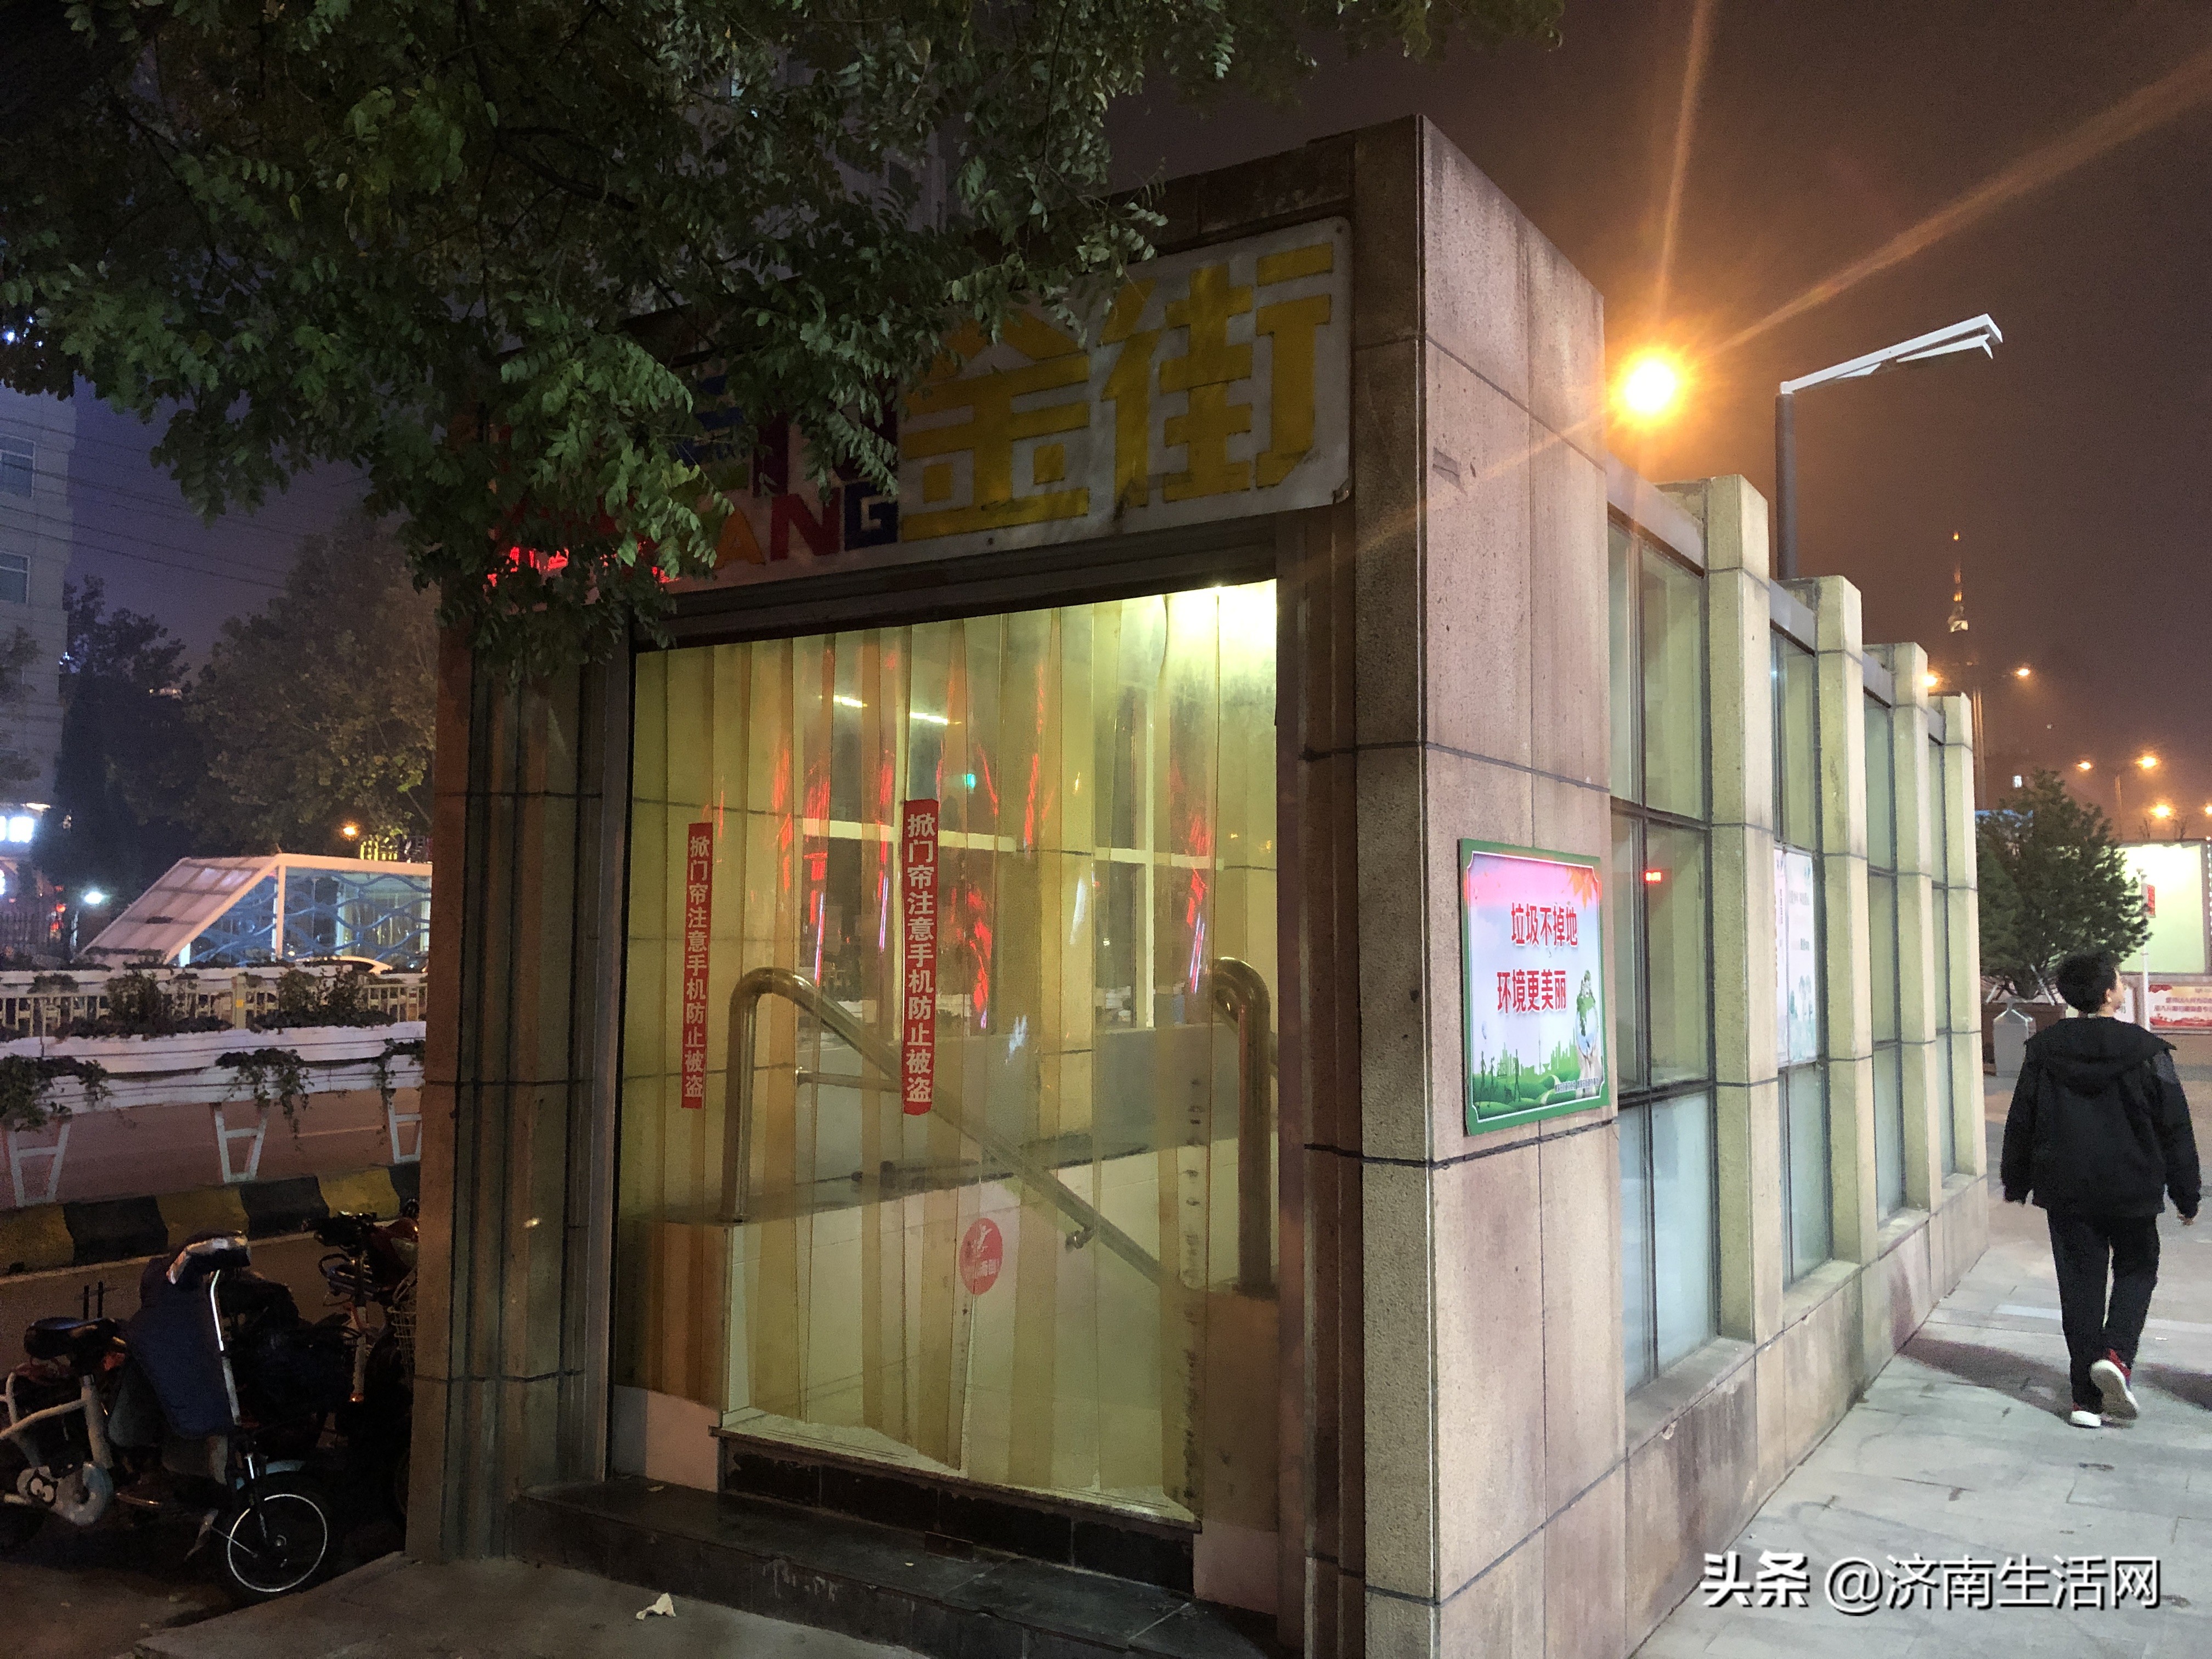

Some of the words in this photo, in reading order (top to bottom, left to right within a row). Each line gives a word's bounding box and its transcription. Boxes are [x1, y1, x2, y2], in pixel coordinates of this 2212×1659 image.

[684, 836, 709, 1098] 掀门帘注意手机防止被盗
[906, 812, 936, 1103] 掀门帘注意手机防止被盗
[1497, 969, 1567, 1014] 环境更美丽
[1511, 902, 1578, 946] 垃圾不掉地
